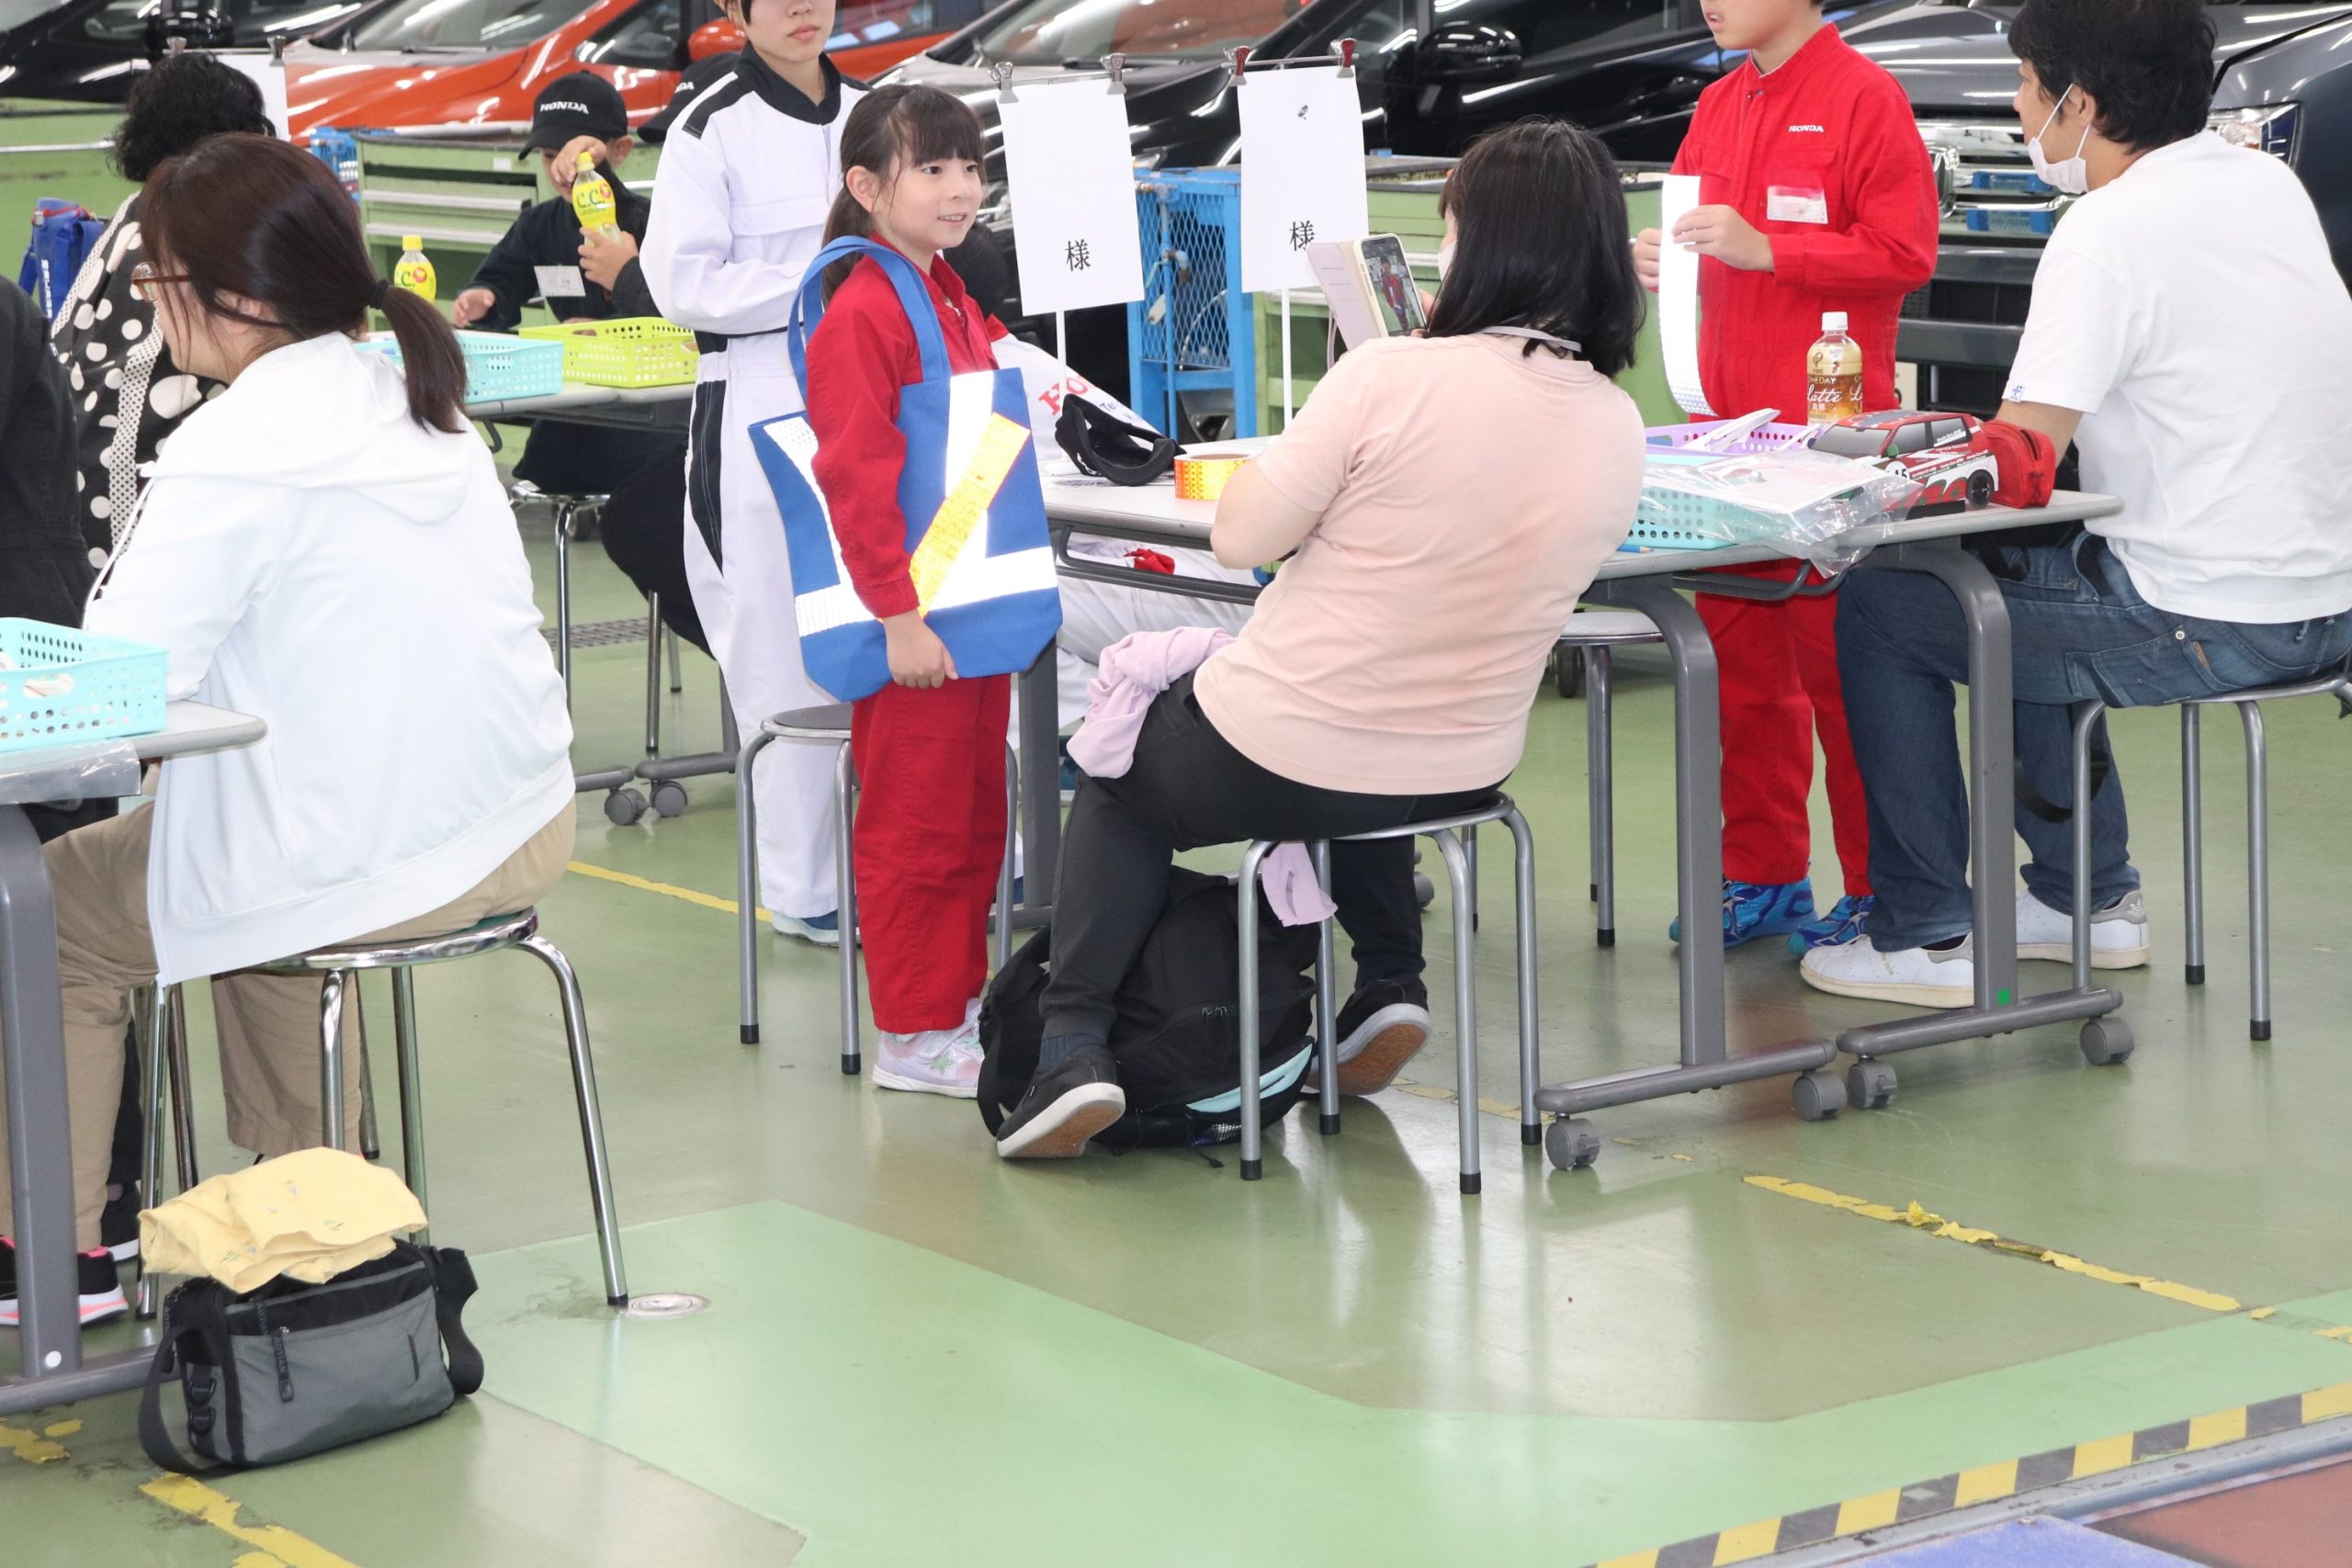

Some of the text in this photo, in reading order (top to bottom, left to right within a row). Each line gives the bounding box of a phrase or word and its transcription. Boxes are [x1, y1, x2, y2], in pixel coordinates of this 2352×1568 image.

[539, 100, 589, 115] HONDA
[1788, 124, 1825, 132] HONDA
[1289, 220, 1316, 252] 様
[1065, 238, 1091, 273] 様
